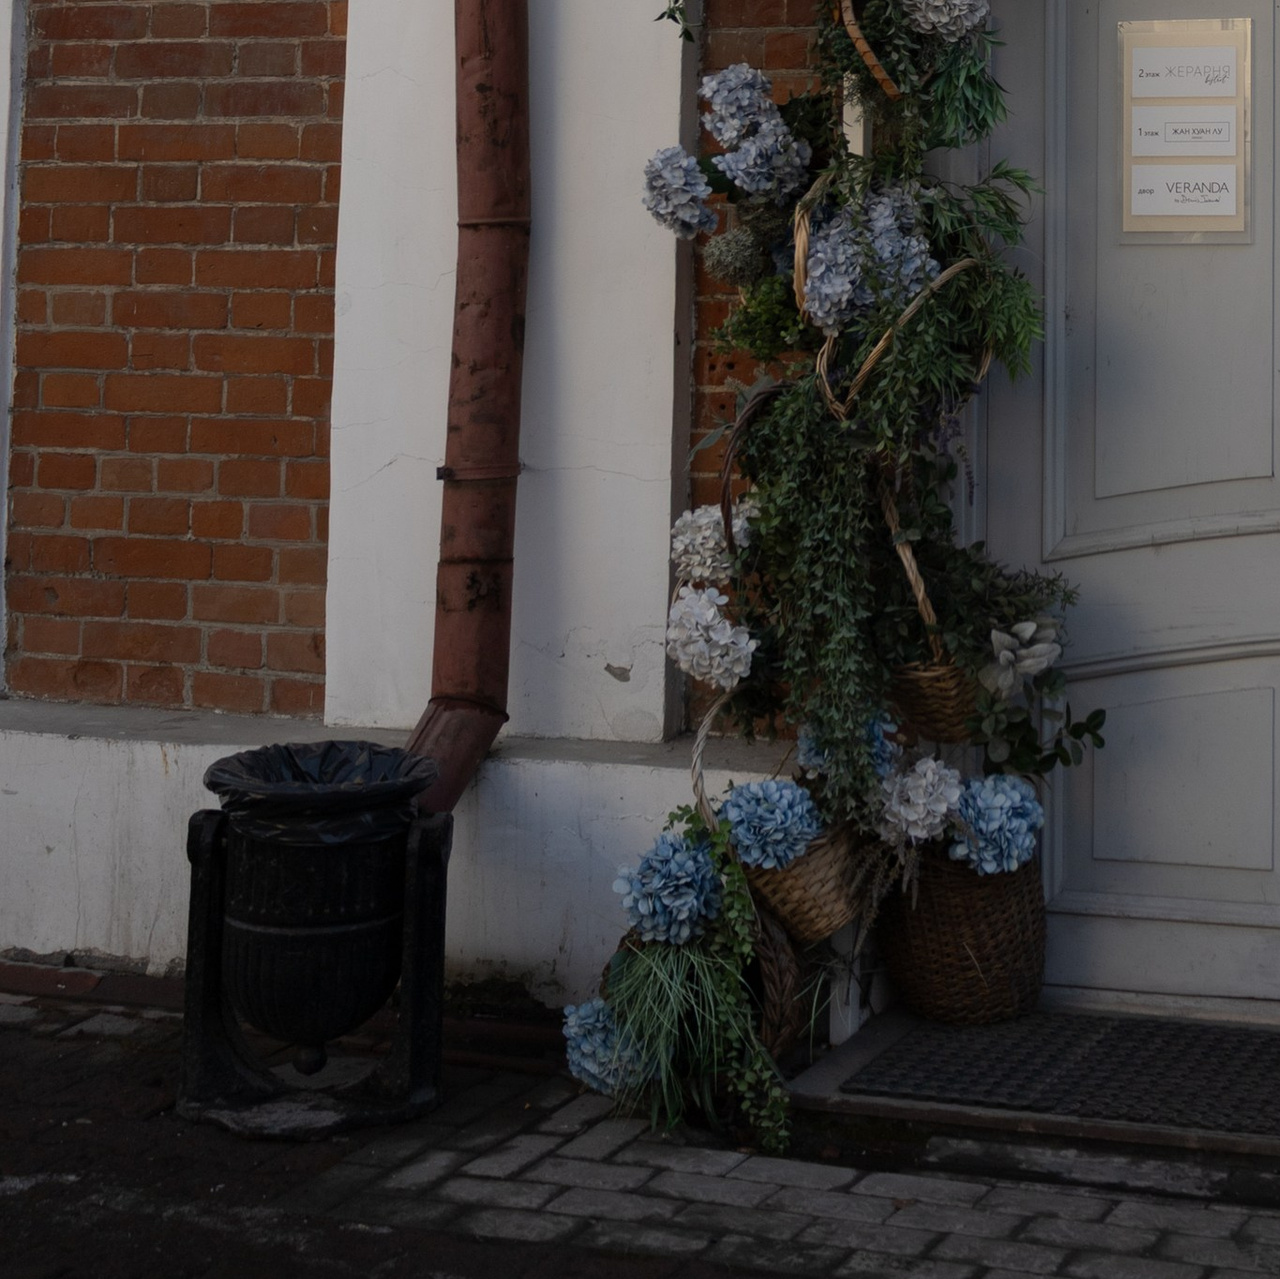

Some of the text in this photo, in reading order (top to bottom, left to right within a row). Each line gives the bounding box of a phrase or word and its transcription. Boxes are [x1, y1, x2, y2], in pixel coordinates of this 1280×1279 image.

[1139, 69, 1144, 78] 2
[1165, 65, 1231, 78] ЖЕРАРНЯ
[1165, 182, 1230, 194] VERANDA
